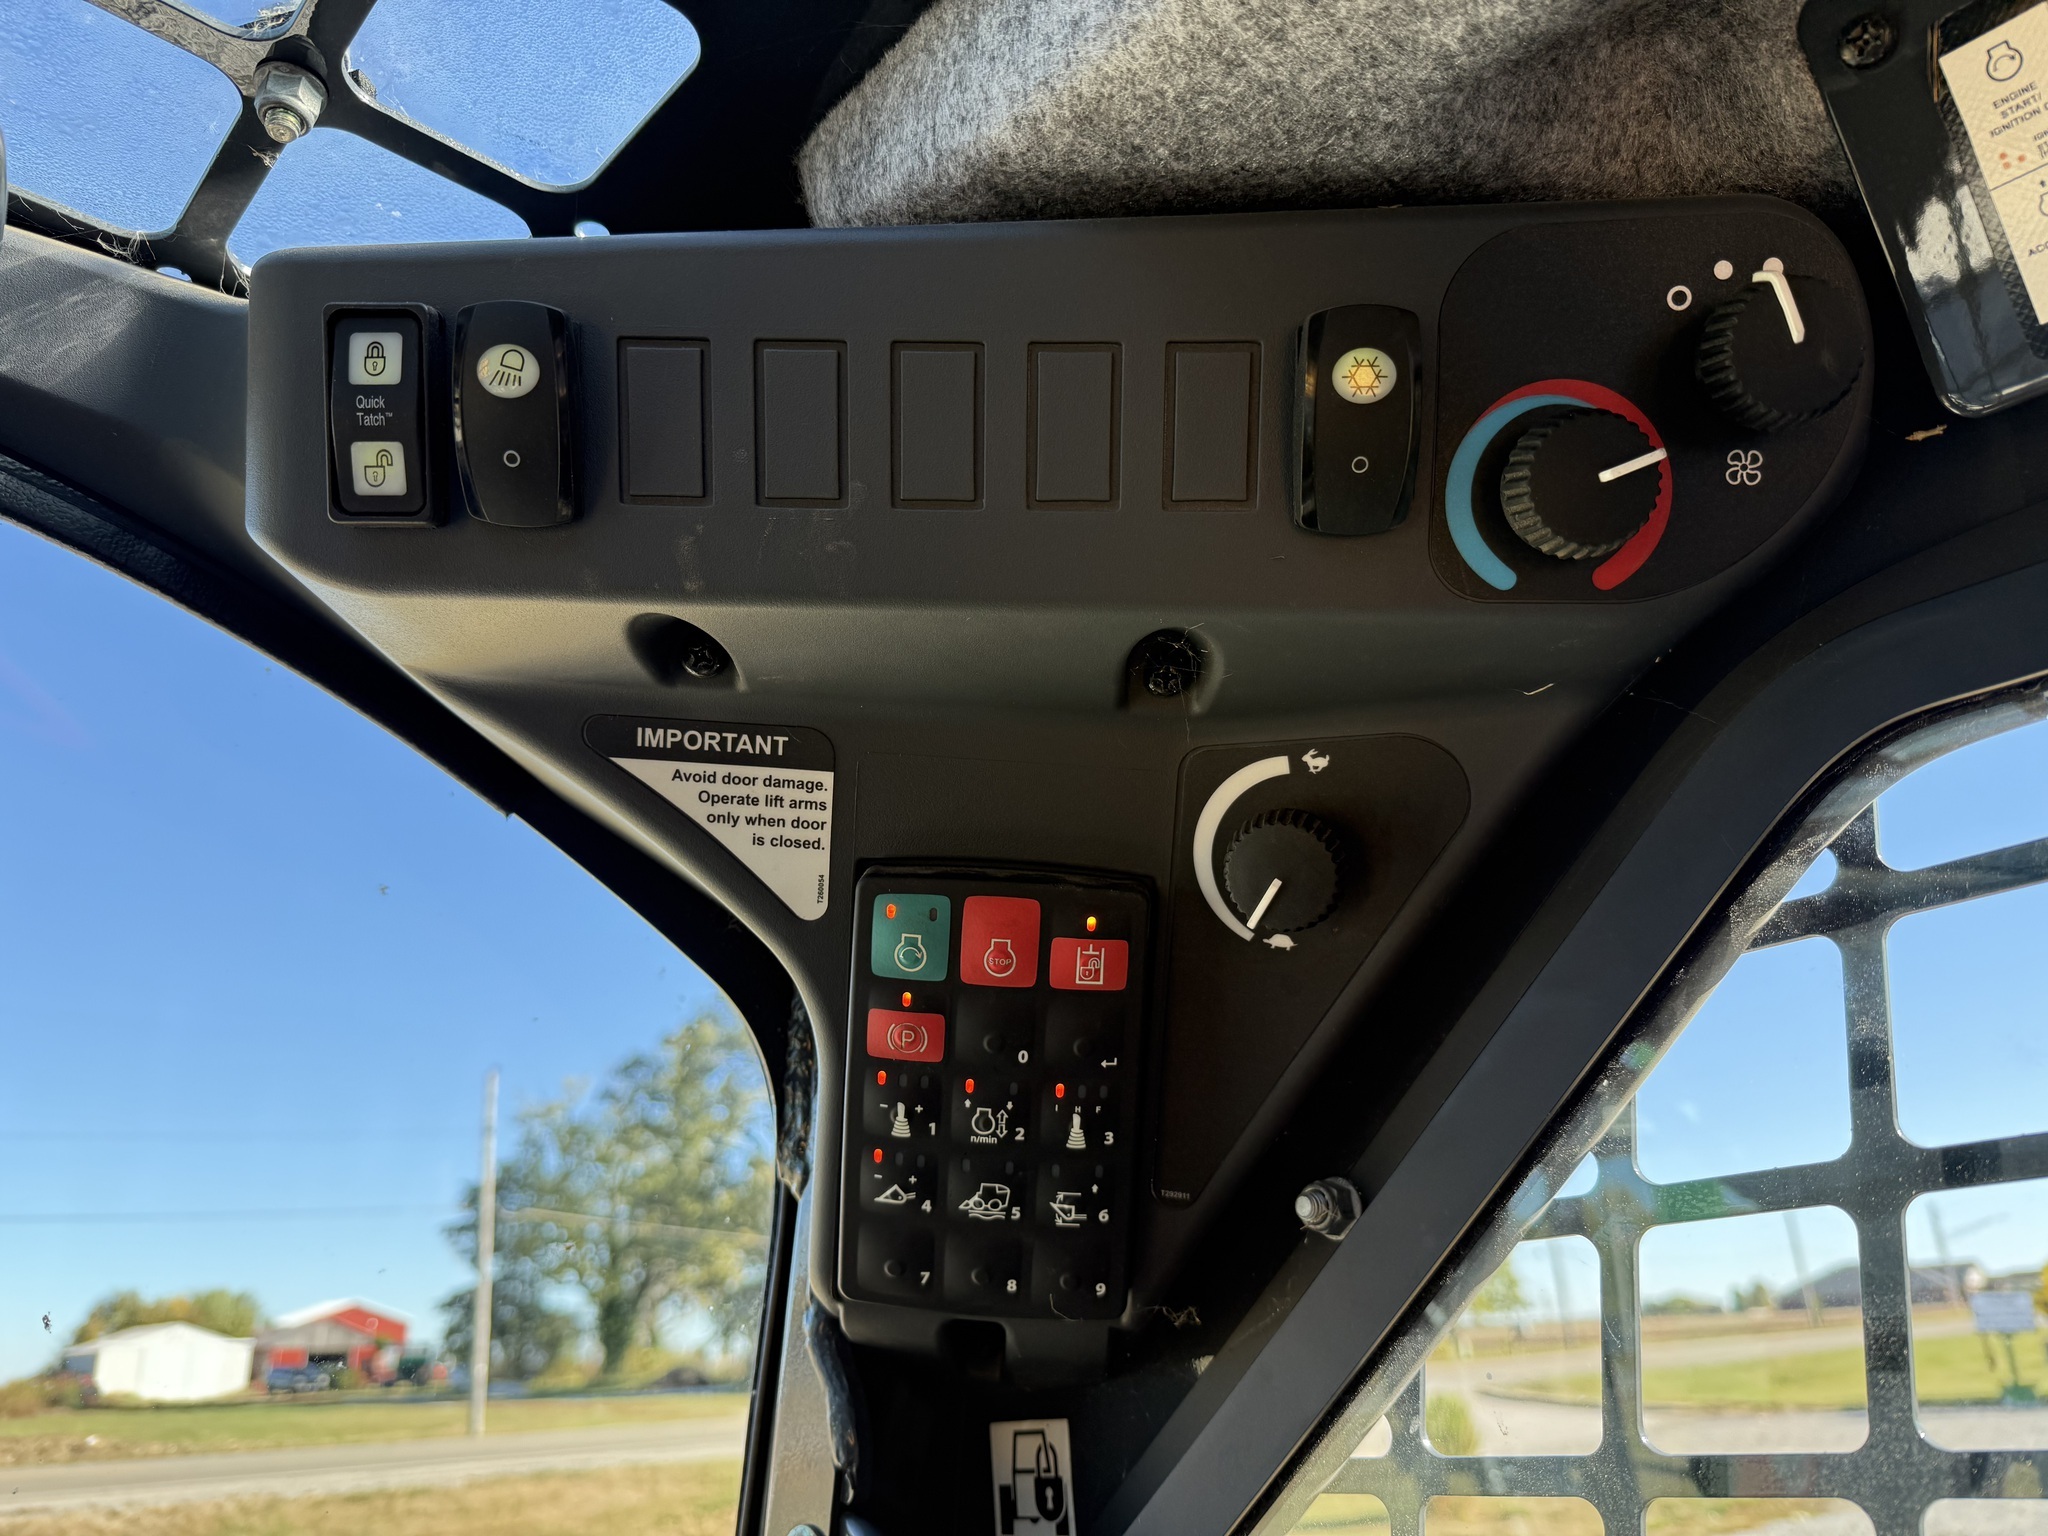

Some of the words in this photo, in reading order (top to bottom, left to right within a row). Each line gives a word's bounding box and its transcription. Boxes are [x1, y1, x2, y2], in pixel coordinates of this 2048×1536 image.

[1993, 81, 2038, 109] ENGINE
[1989, 106, 2042, 138] IGNITION
[355, 395, 386, 410] Quick
[636, 726, 789, 756] IMPORTANT
[671, 768, 717, 784] Avoid
[721, 771, 759, 787] door
[762, 774, 828, 793] damage.
[698, 790, 760, 807] Operate
[764, 794, 785, 809] lift
[788, 798, 828, 811] arms
[706, 811, 740, 827] only
[744, 814, 786, 828] when
[790, 816, 827, 831] door
[752, 833, 765, 846] is
[770, 834, 826, 851] closed.
[987, 956, 1012, 967] STOP
[901, 1030, 915, 1048] P
[1018, 1050, 1028, 1063] 0
[1075, 1105, 1081, 1113] H
[928, 1122, 937, 1136] 1
[1014, 1127, 1025, 1141] 2
[970, 1135, 998, 1145] n/min
[1104, 1131, 1114, 1145] 3
[921, 1200, 932, 1213] 4
[1011, 1207, 1021, 1220] 5
[1098, 1209, 1109, 1223] 6
[920, 1271, 931, 1285] 7
[1007, 1279, 1017, 1293] 8
[1095, 1283, 1106, 1296] 9
